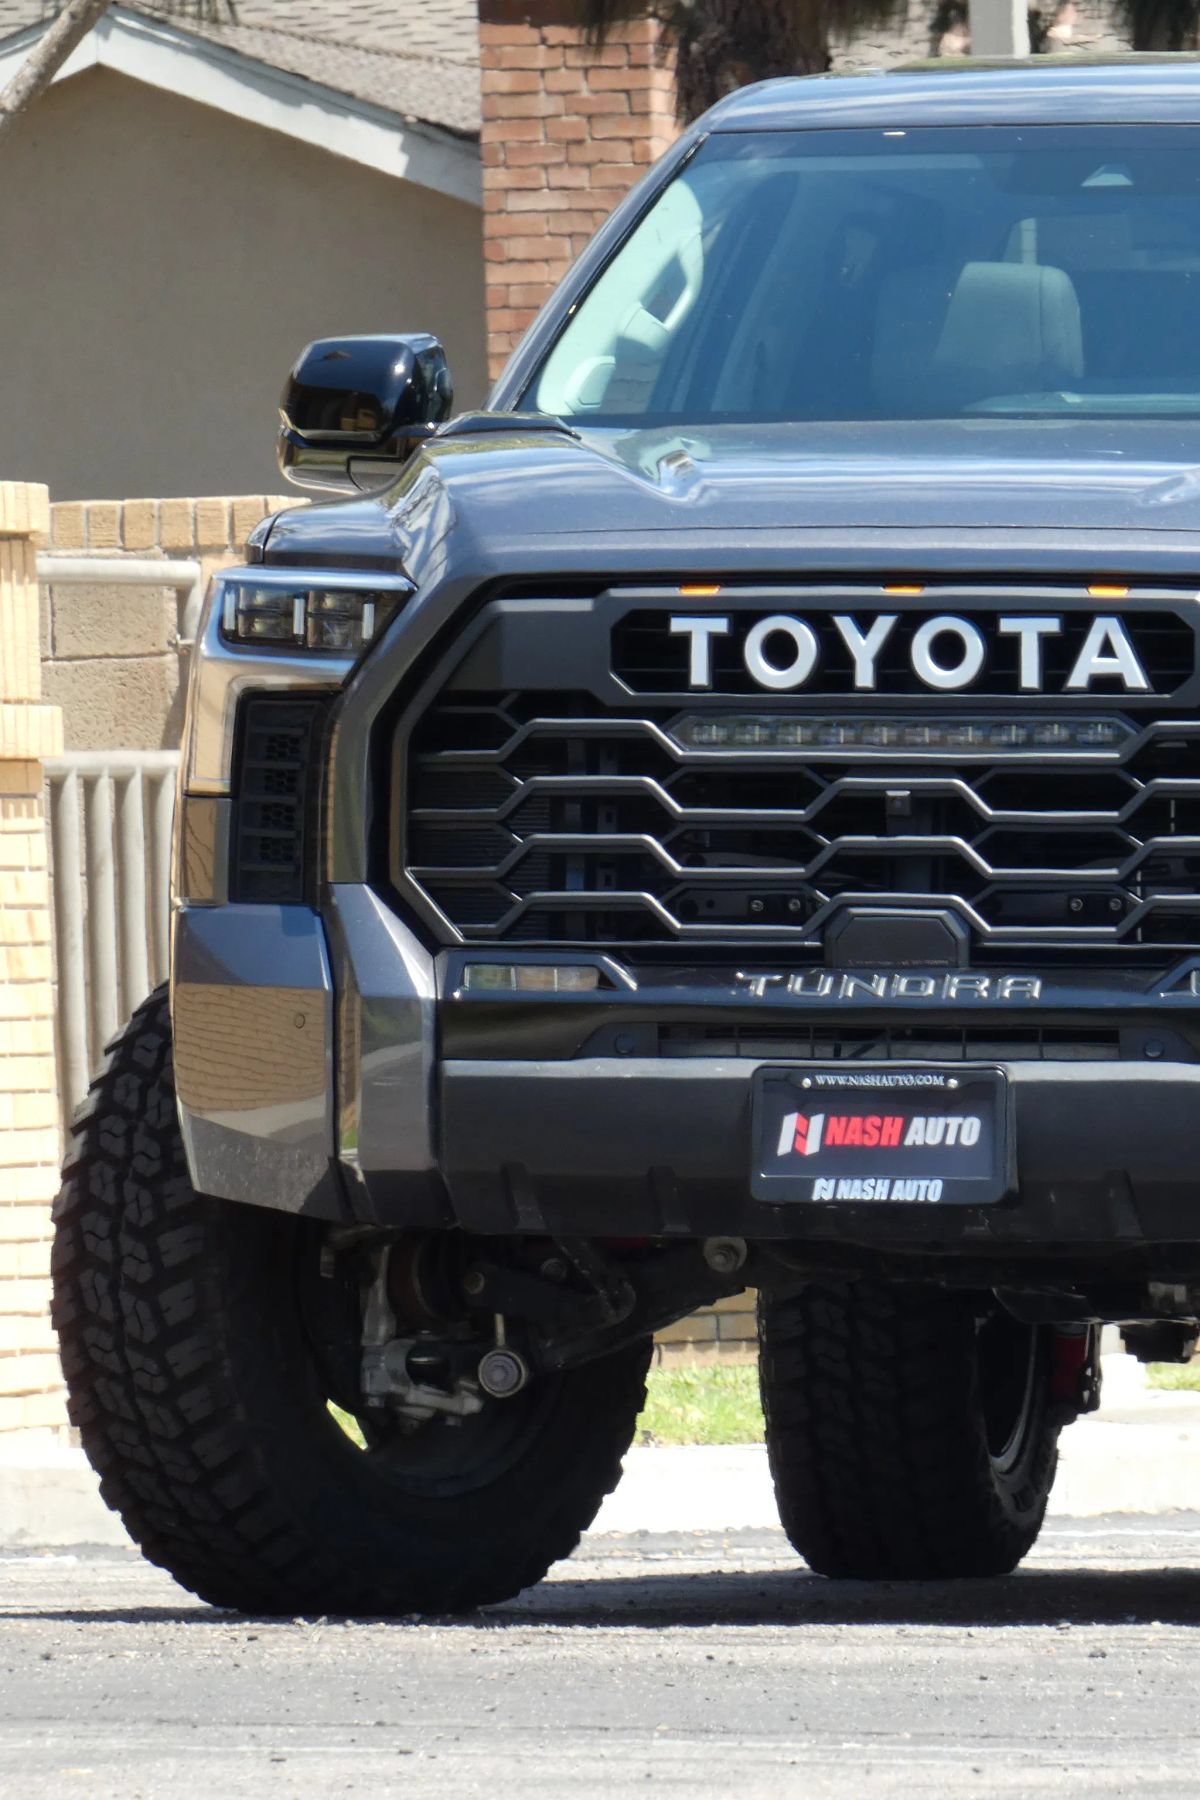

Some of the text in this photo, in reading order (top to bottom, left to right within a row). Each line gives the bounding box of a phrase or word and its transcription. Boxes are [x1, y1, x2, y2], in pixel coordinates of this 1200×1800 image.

[669, 613, 1152, 690] TOYOTA
[732, 970, 1042, 1000] TUNDRA
[815, 1074, 945, 1087] WWW.NASHAUTO.COM
[824, 1114, 904, 1147] NASH
[903, 1116, 982, 1146] AUTO
[836, 1178, 893, 1201] NASH
[892, 1178, 943, 1202] AUTO
